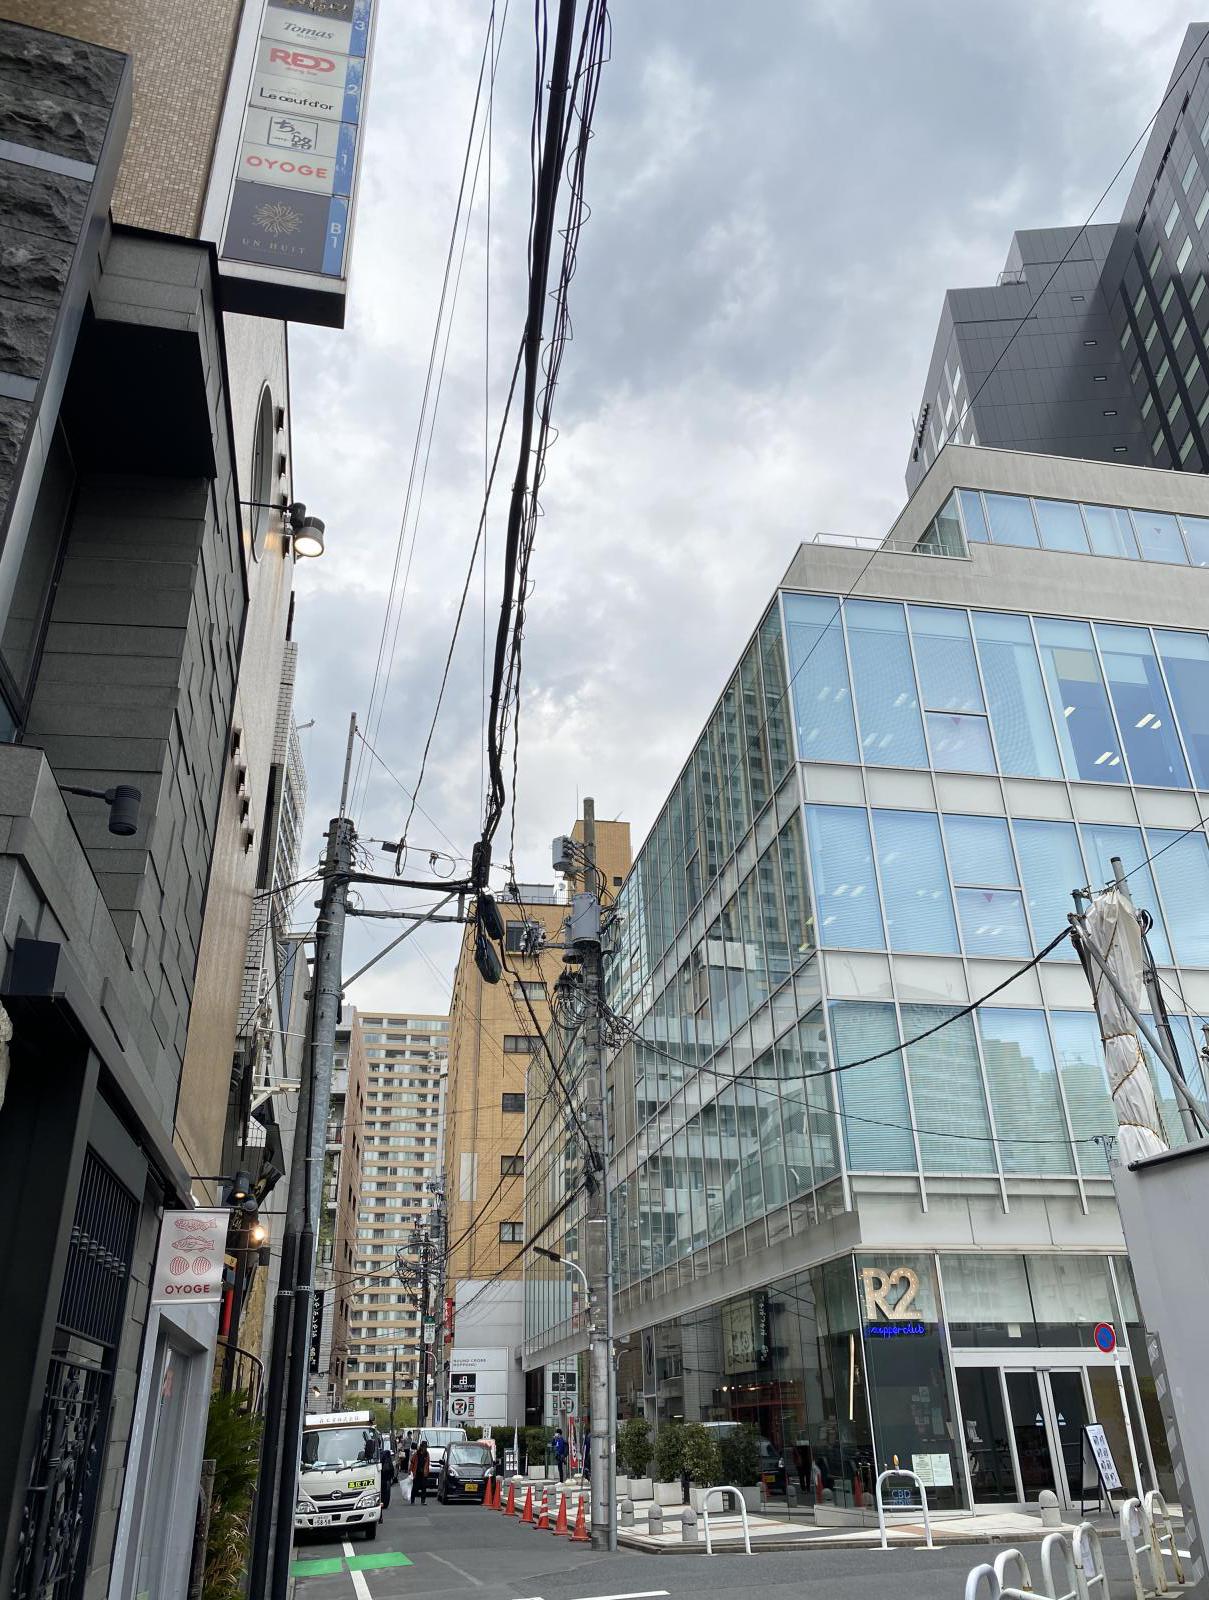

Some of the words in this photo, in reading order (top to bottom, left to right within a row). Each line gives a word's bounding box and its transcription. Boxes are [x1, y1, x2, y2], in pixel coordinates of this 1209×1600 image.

[283, 21, 334, 40] Tomas
[354, 20, 365, 31] 3
[347, 84, 358, 95] 2
[246, 155, 328, 179] OYOGE
[165, 1284, 210, 1295] OYOGE
[862, 1267, 923, 1320] R2
